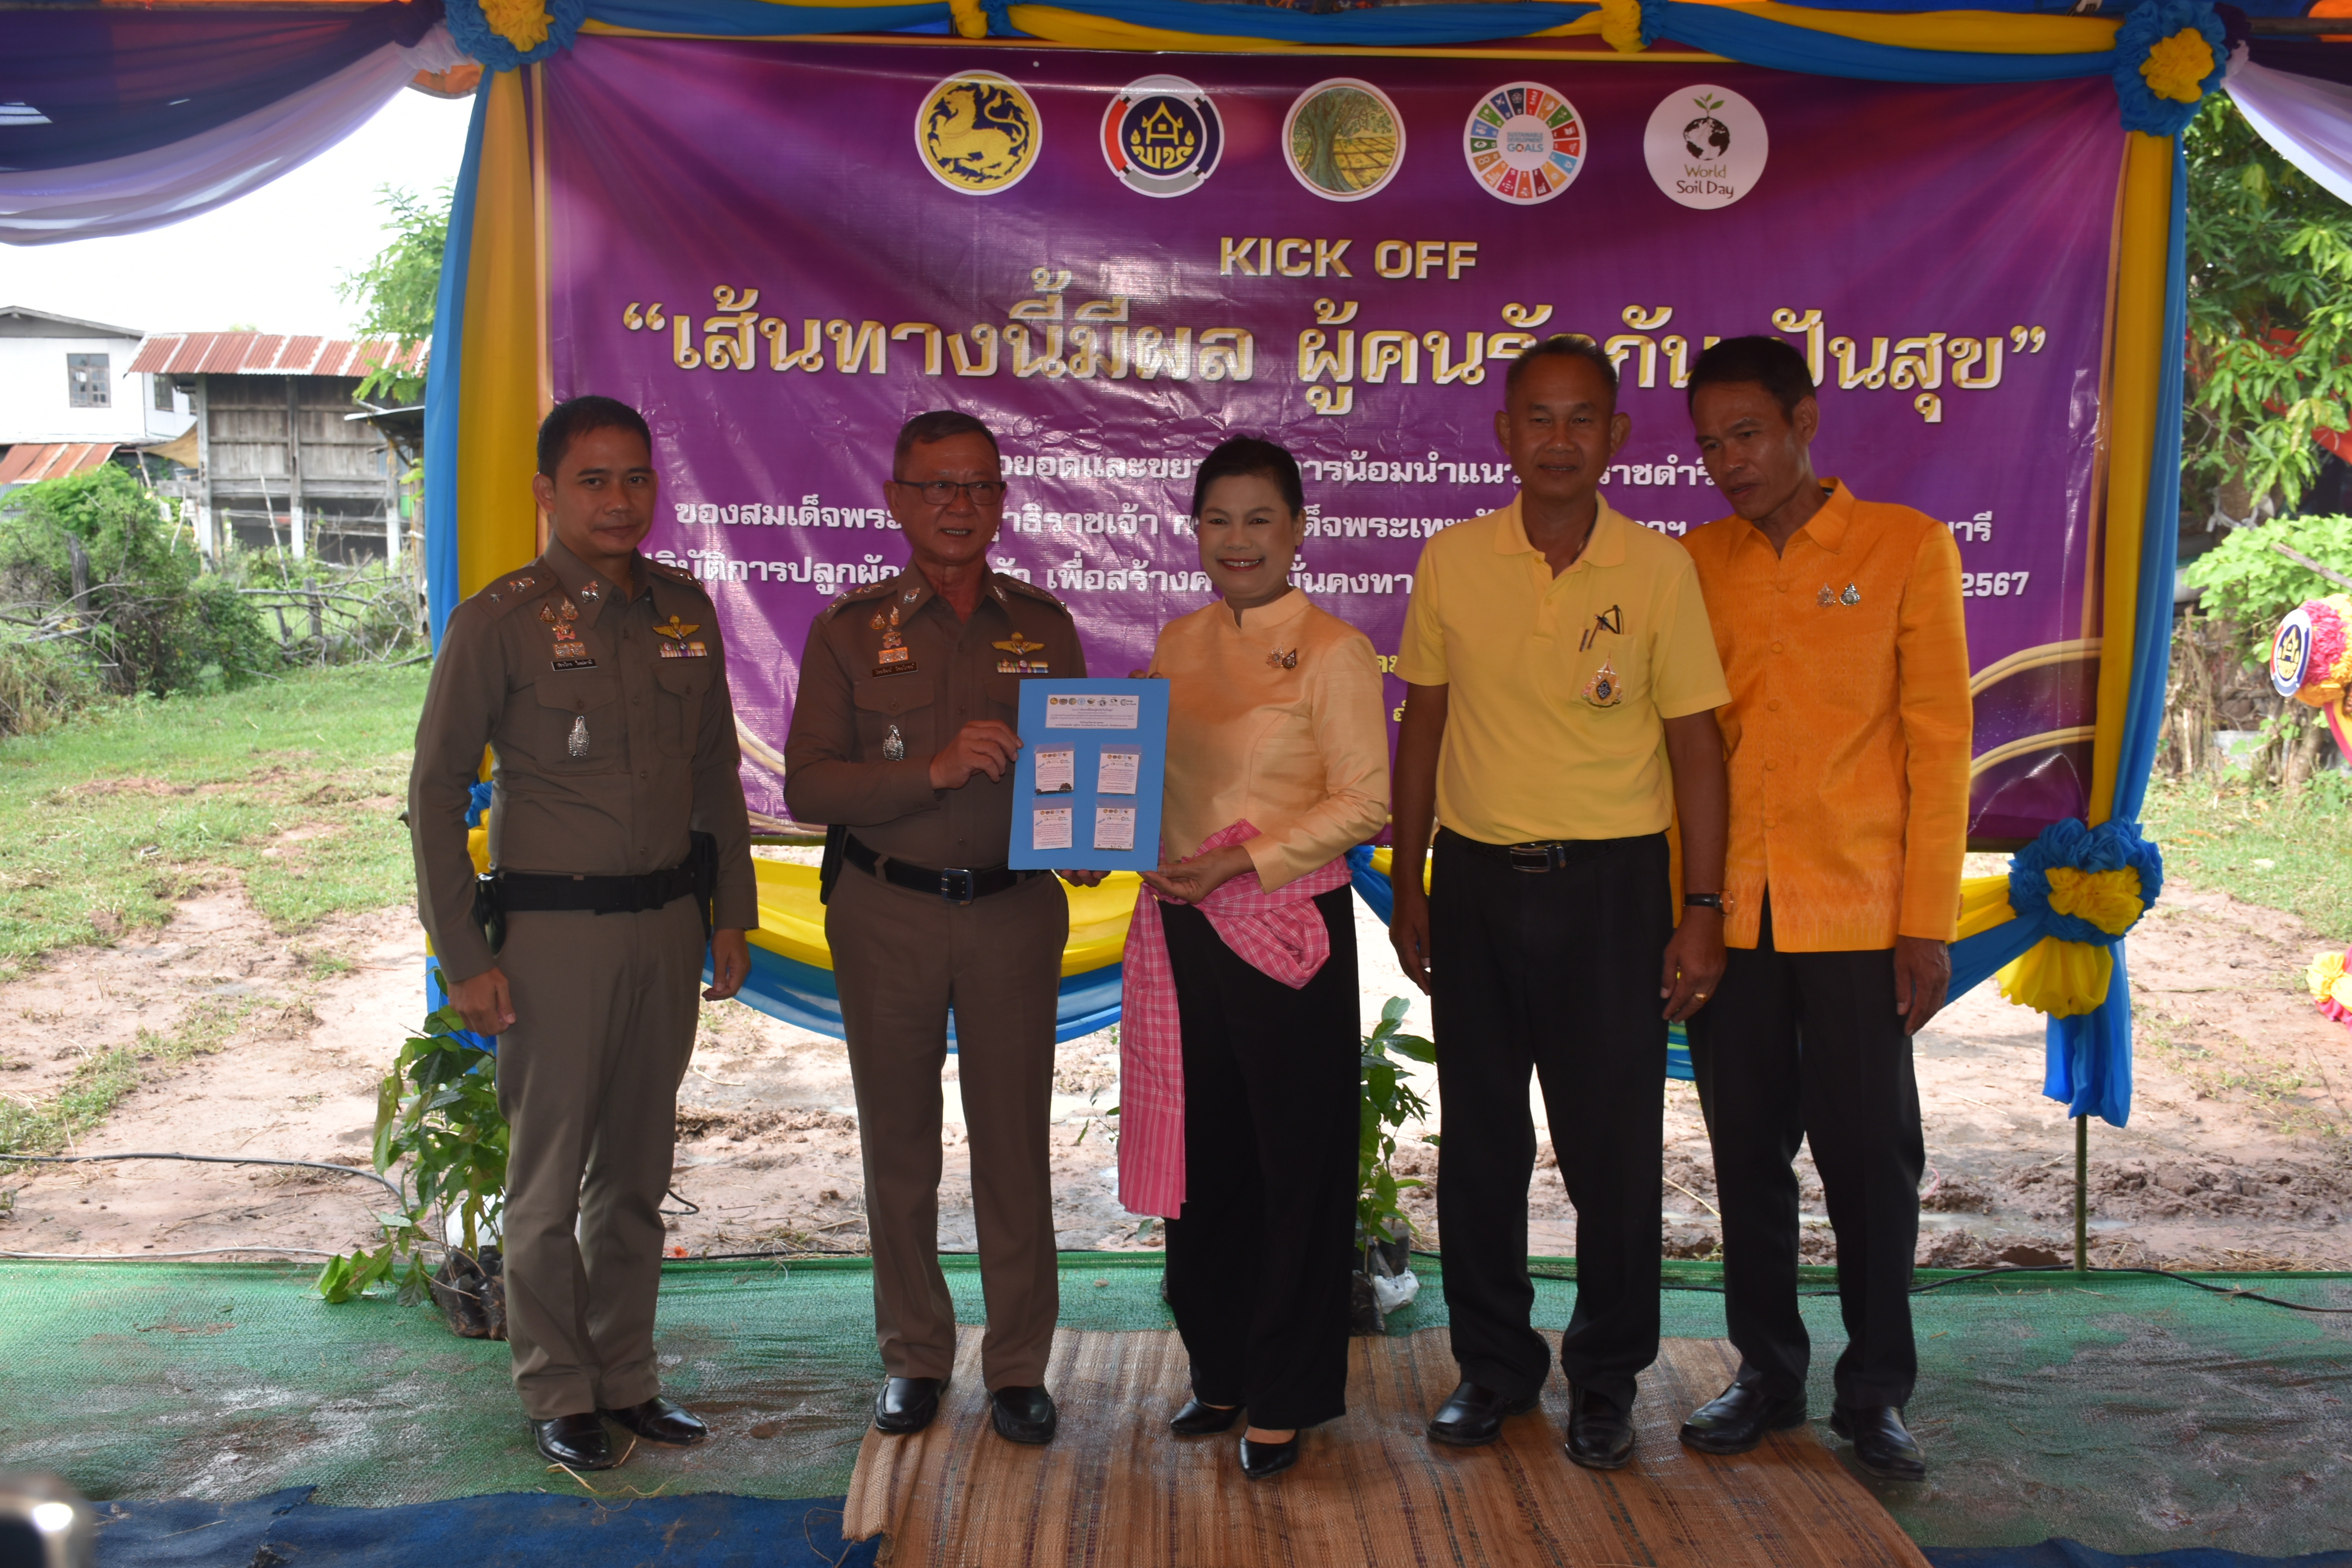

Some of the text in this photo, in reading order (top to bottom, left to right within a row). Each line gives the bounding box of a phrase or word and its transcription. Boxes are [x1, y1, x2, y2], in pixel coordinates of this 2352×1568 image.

[1507, 144, 1543, 152] GOALS
[1684, 165, 1726, 178] World
[1677, 181, 1734, 199] Soil Day
[1220, 237, 1478, 279] KICK OFF
[1948, 511, 1992, 541] ารี
[1962, 572, 2029, 597] 2567
